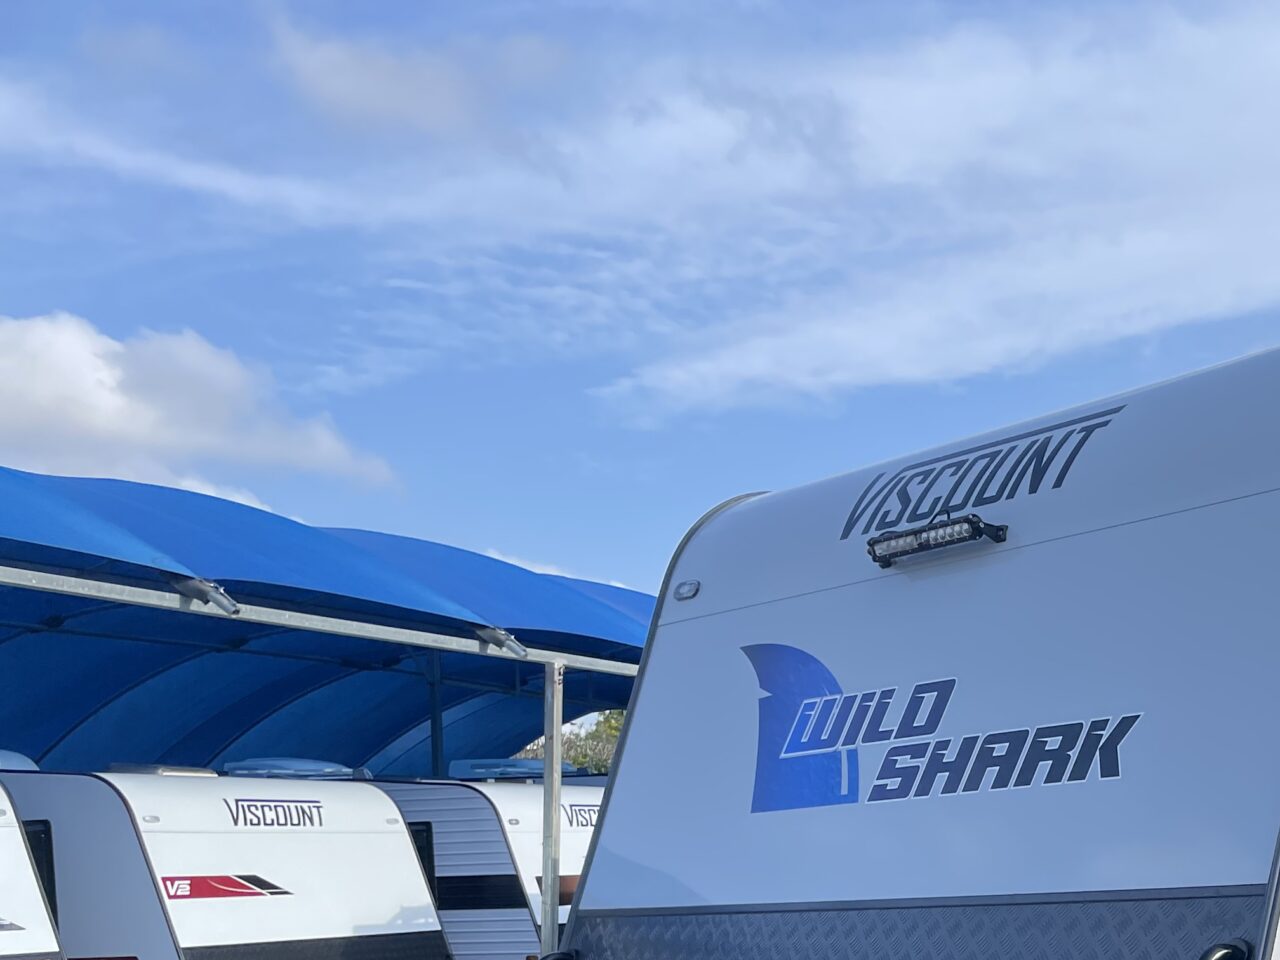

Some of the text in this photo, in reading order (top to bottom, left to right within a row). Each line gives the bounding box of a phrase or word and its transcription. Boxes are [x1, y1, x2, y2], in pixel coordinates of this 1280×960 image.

[840, 404, 1127, 540] VISCOUNT
[780, 677, 957, 759] WILD
[865, 712, 1144, 804] SHARK
[222, 798, 323, 827] VISCOUNT
[560, 804, 600, 827] VISC
